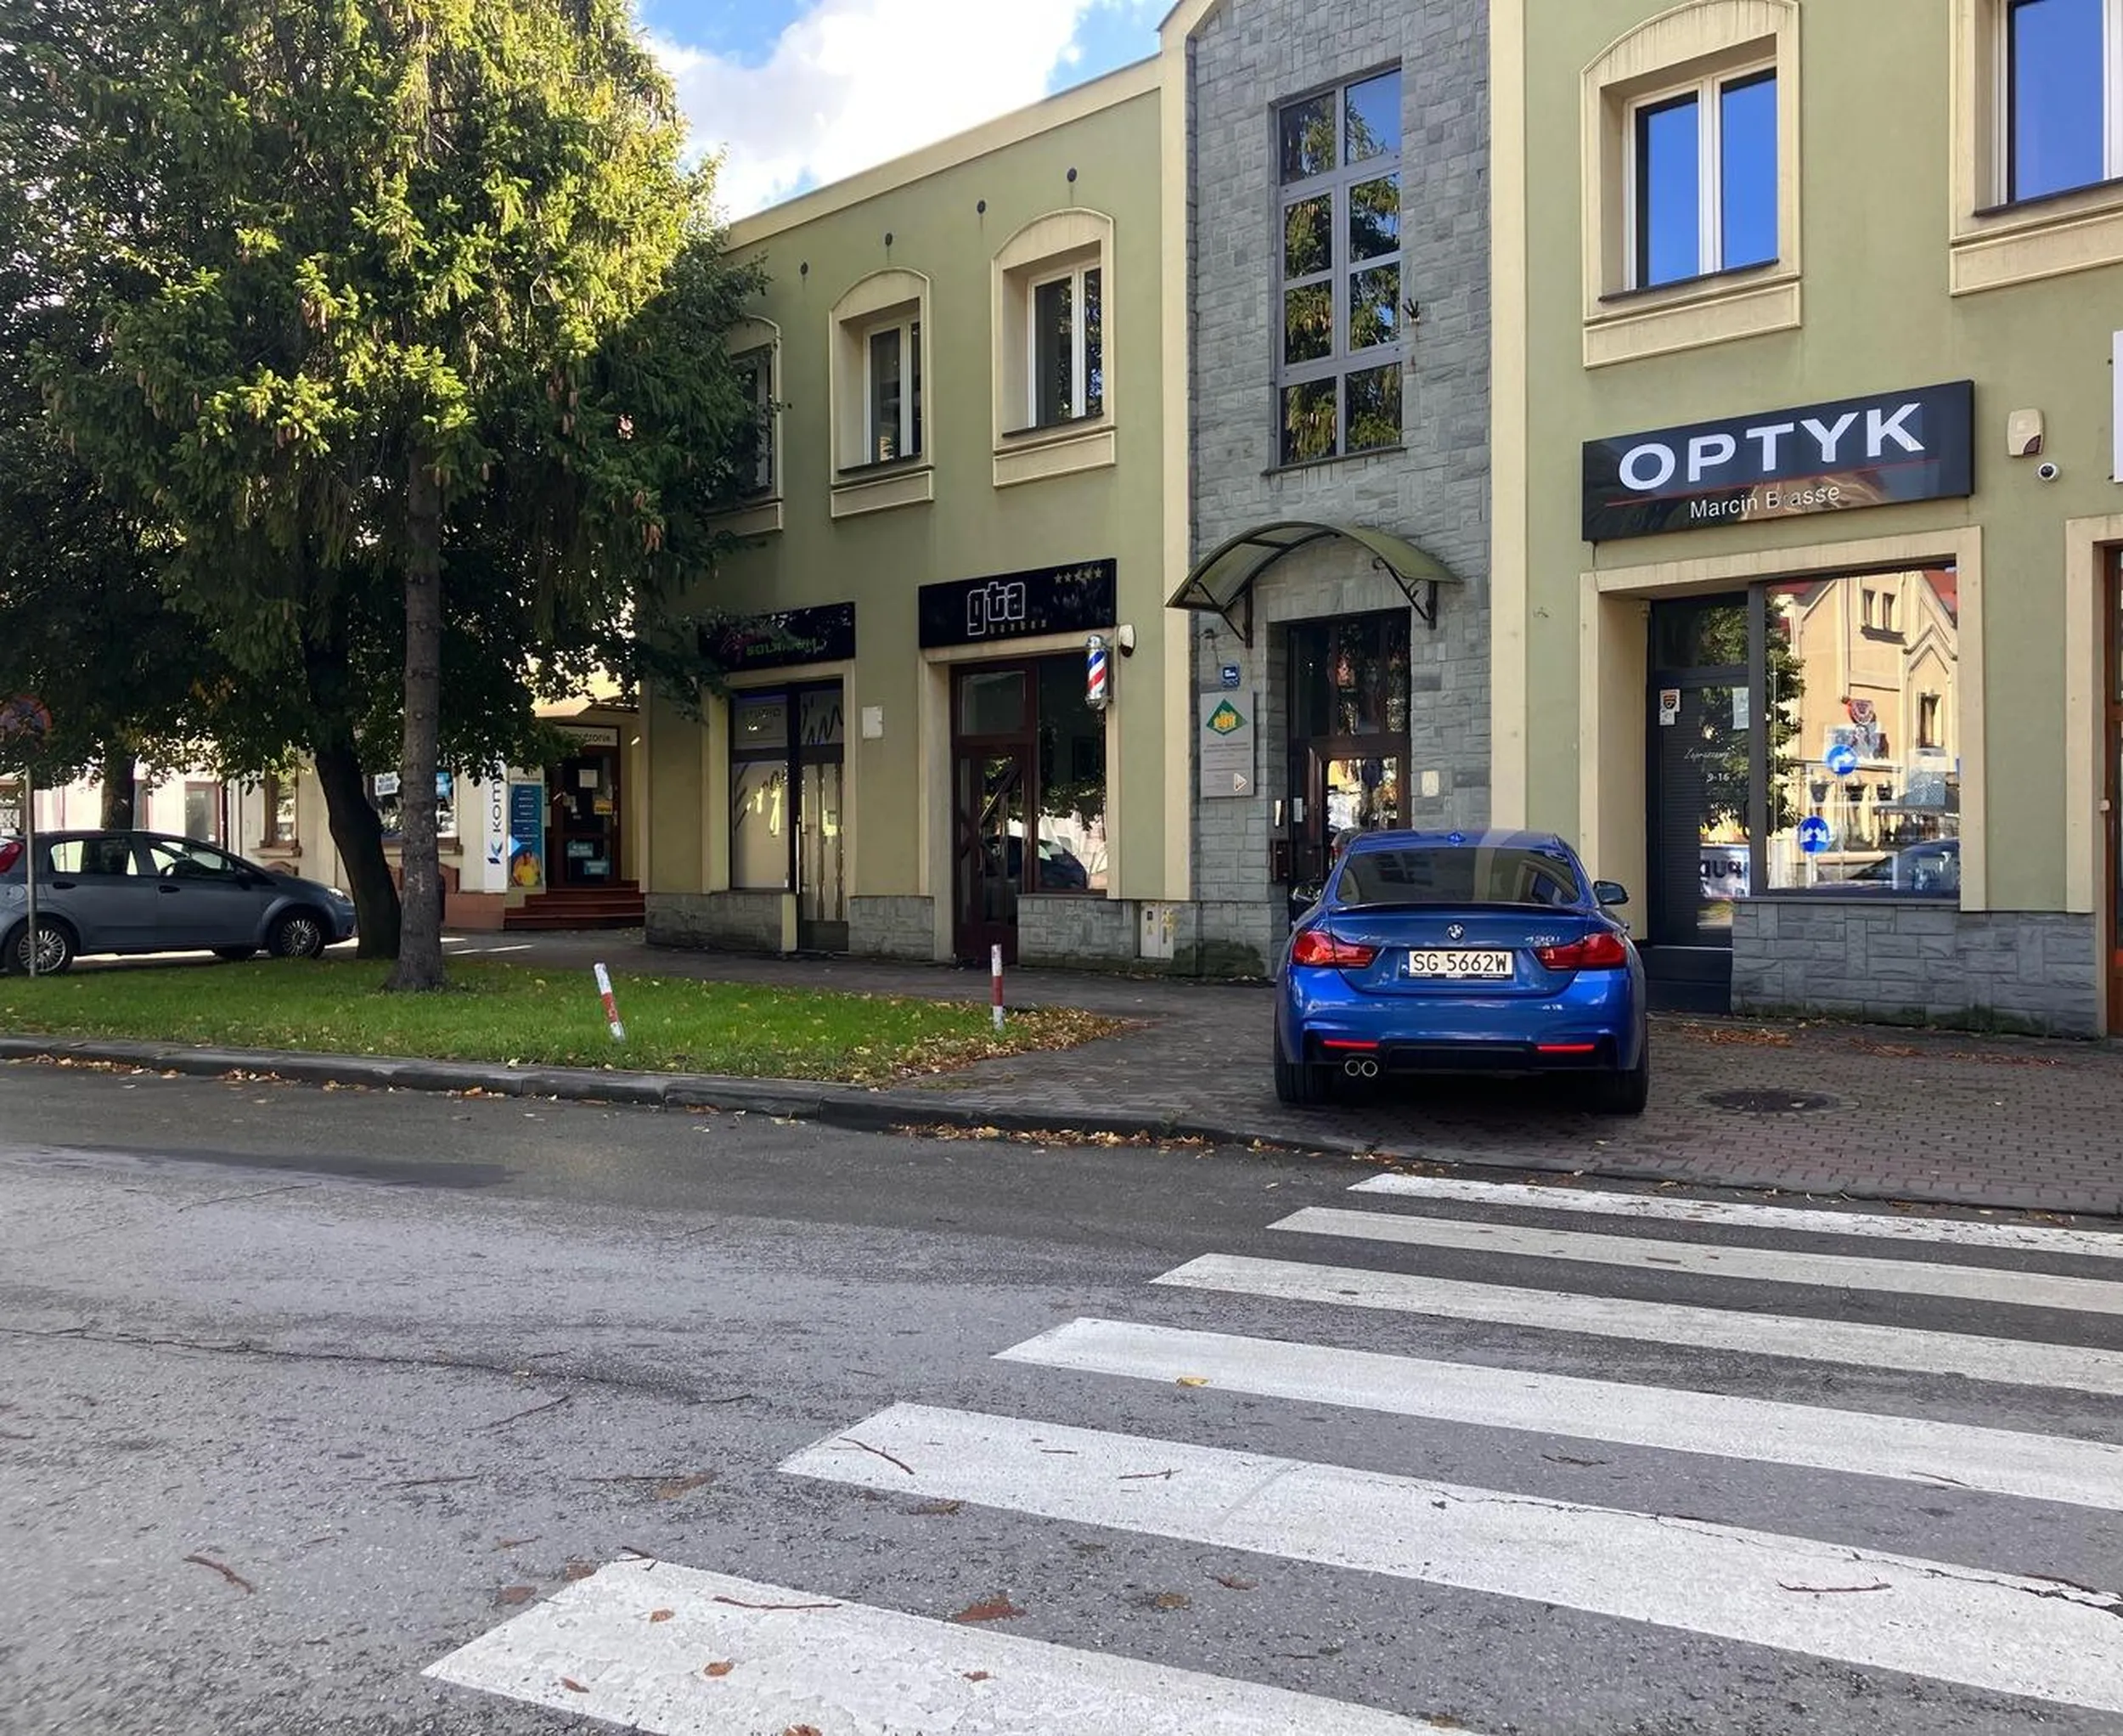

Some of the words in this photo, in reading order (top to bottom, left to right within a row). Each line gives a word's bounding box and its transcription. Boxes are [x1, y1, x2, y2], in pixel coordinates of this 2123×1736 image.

[1619, 403, 1925, 491] OPTYK
[1690, 493, 1757, 518] Marcin
[967, 581, 1025, 635] gta
[1413, 953, 1439, 972] SG
[1445, 953, 1507, 972] 5662W
